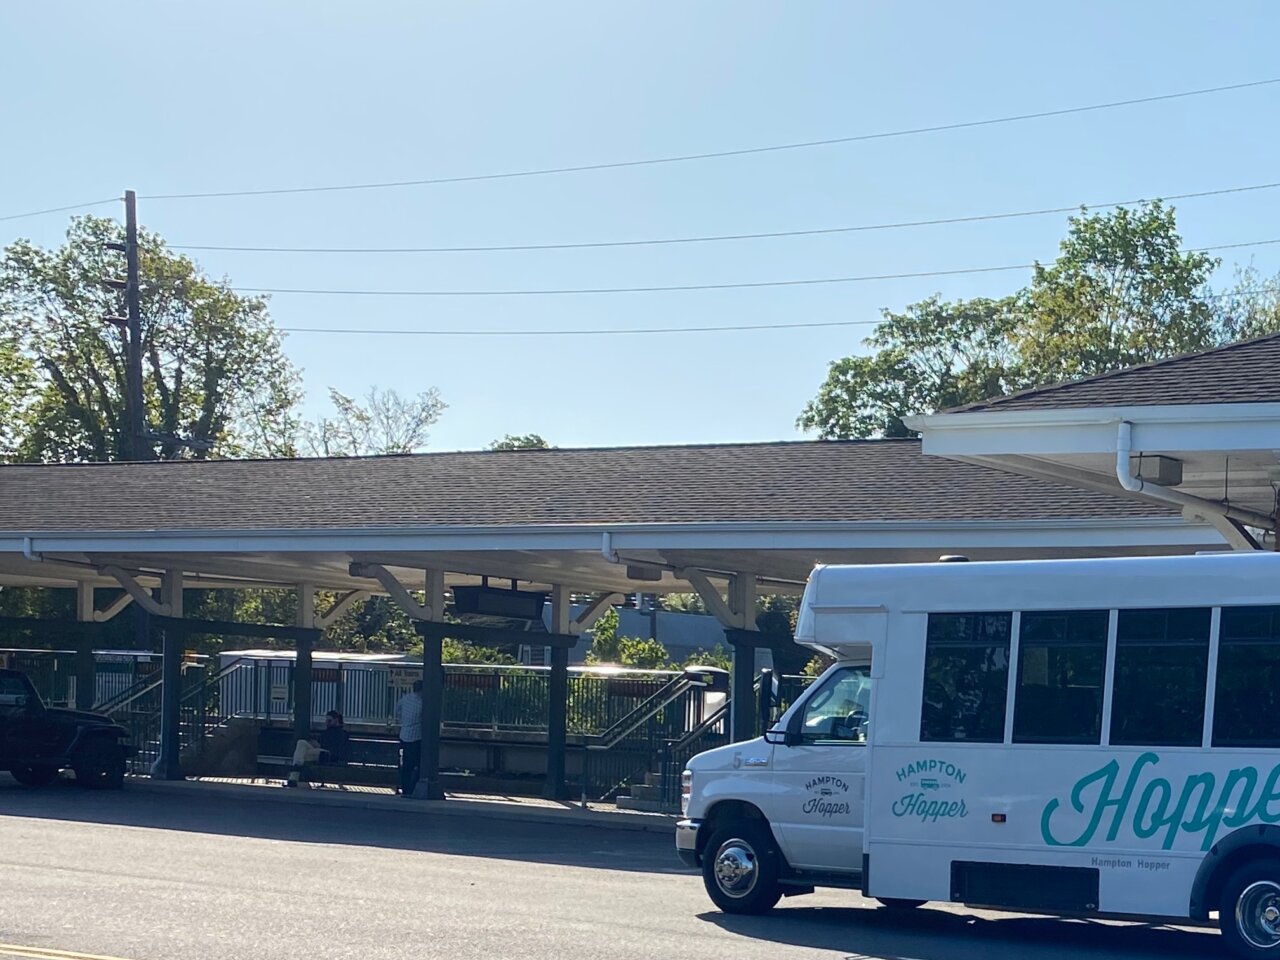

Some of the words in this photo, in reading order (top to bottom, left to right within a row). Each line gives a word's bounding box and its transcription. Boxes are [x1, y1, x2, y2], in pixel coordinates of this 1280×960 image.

[733, 751, 742, 769] 5
[896, 759, 967, 784] HAMPTON
[805, 776, 849, 792] HAMPTON
[802, 798, 851, 818] Hopper
[892, 793, 969, 822] Hopper
[1091, 857, 1132, 869] Hampton
[1137, 859, 1171, 871] Hopper
